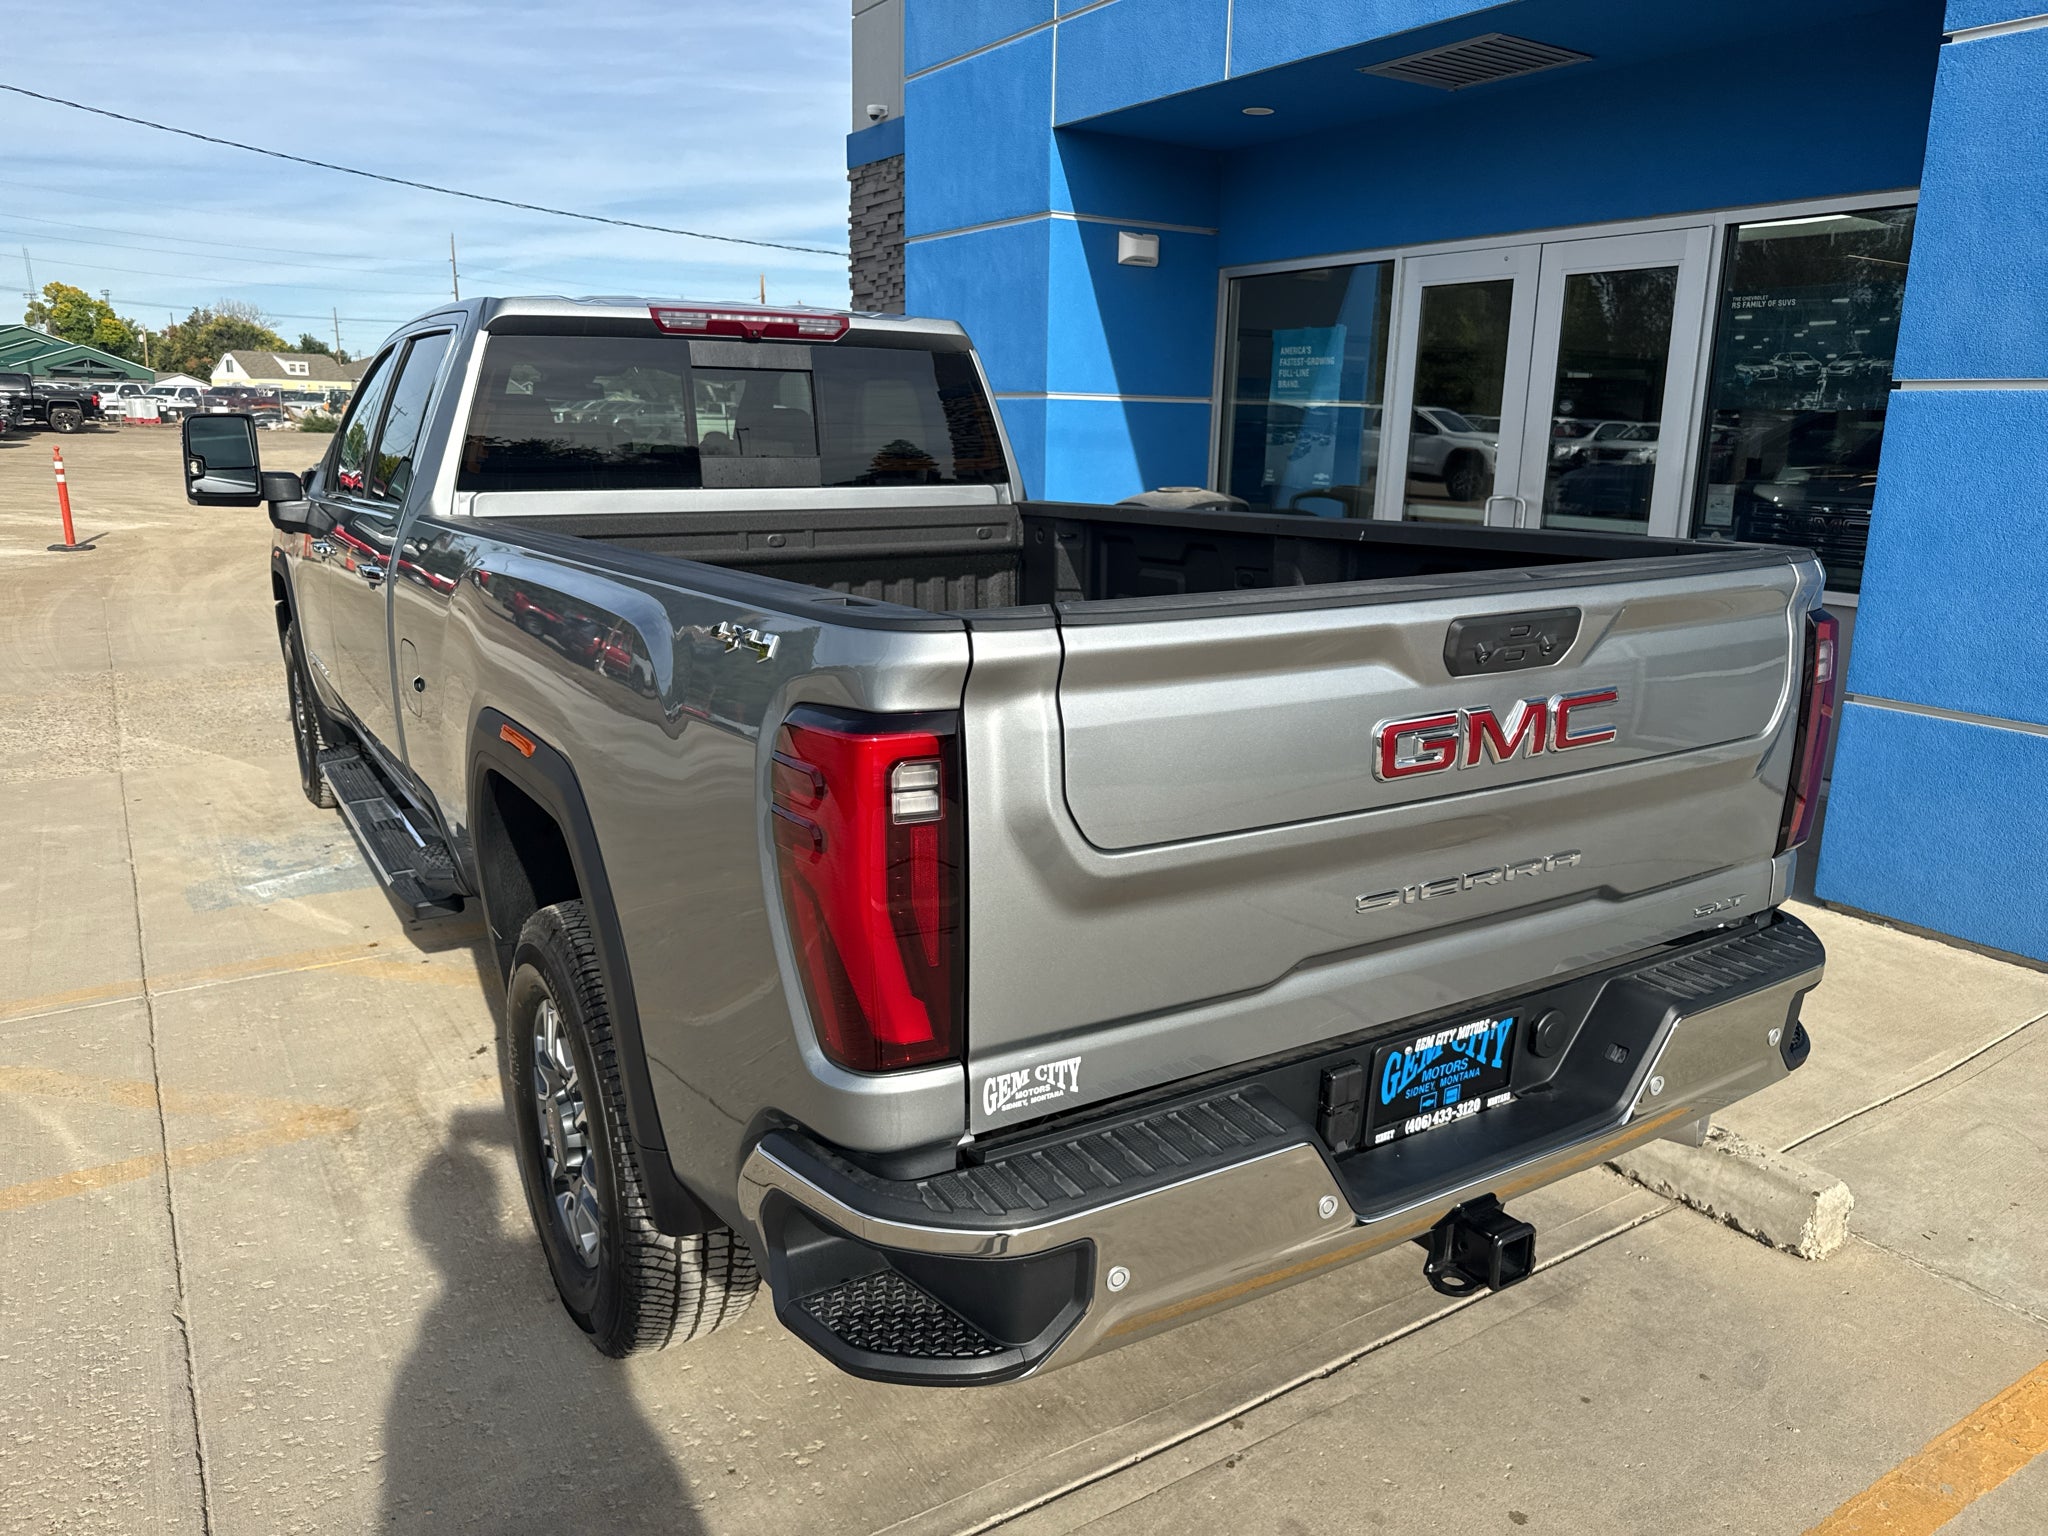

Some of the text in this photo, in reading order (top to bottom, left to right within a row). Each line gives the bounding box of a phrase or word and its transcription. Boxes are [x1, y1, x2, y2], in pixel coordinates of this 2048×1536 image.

[1279, 356, 1335, 366] FASTEST-GROWING
[1280, 346, 1312, 355] AMERICA'S
[1278, 368, 1310, 377] FULL-LINE
[1371, 686, 1619, 783] GMC
[1355, 849, 1582, 914] SIERRA
[1693, 893, 1748, 919] SLT
[1414, 1018, 1491, 1053] GEM CITY MOTORS
[1381, 1045, 1444, 1105] GEM
[1421, 1057, 1469, 1083] MOTORS
[1439, 1067, 1481, 1088] MONTANA
[983, 1055, 1082, 1116] GEM CITY
[1015, 1084, 1051, 1100] MOTORS
[1030, 1089, 1065, 1104] MONTANA
